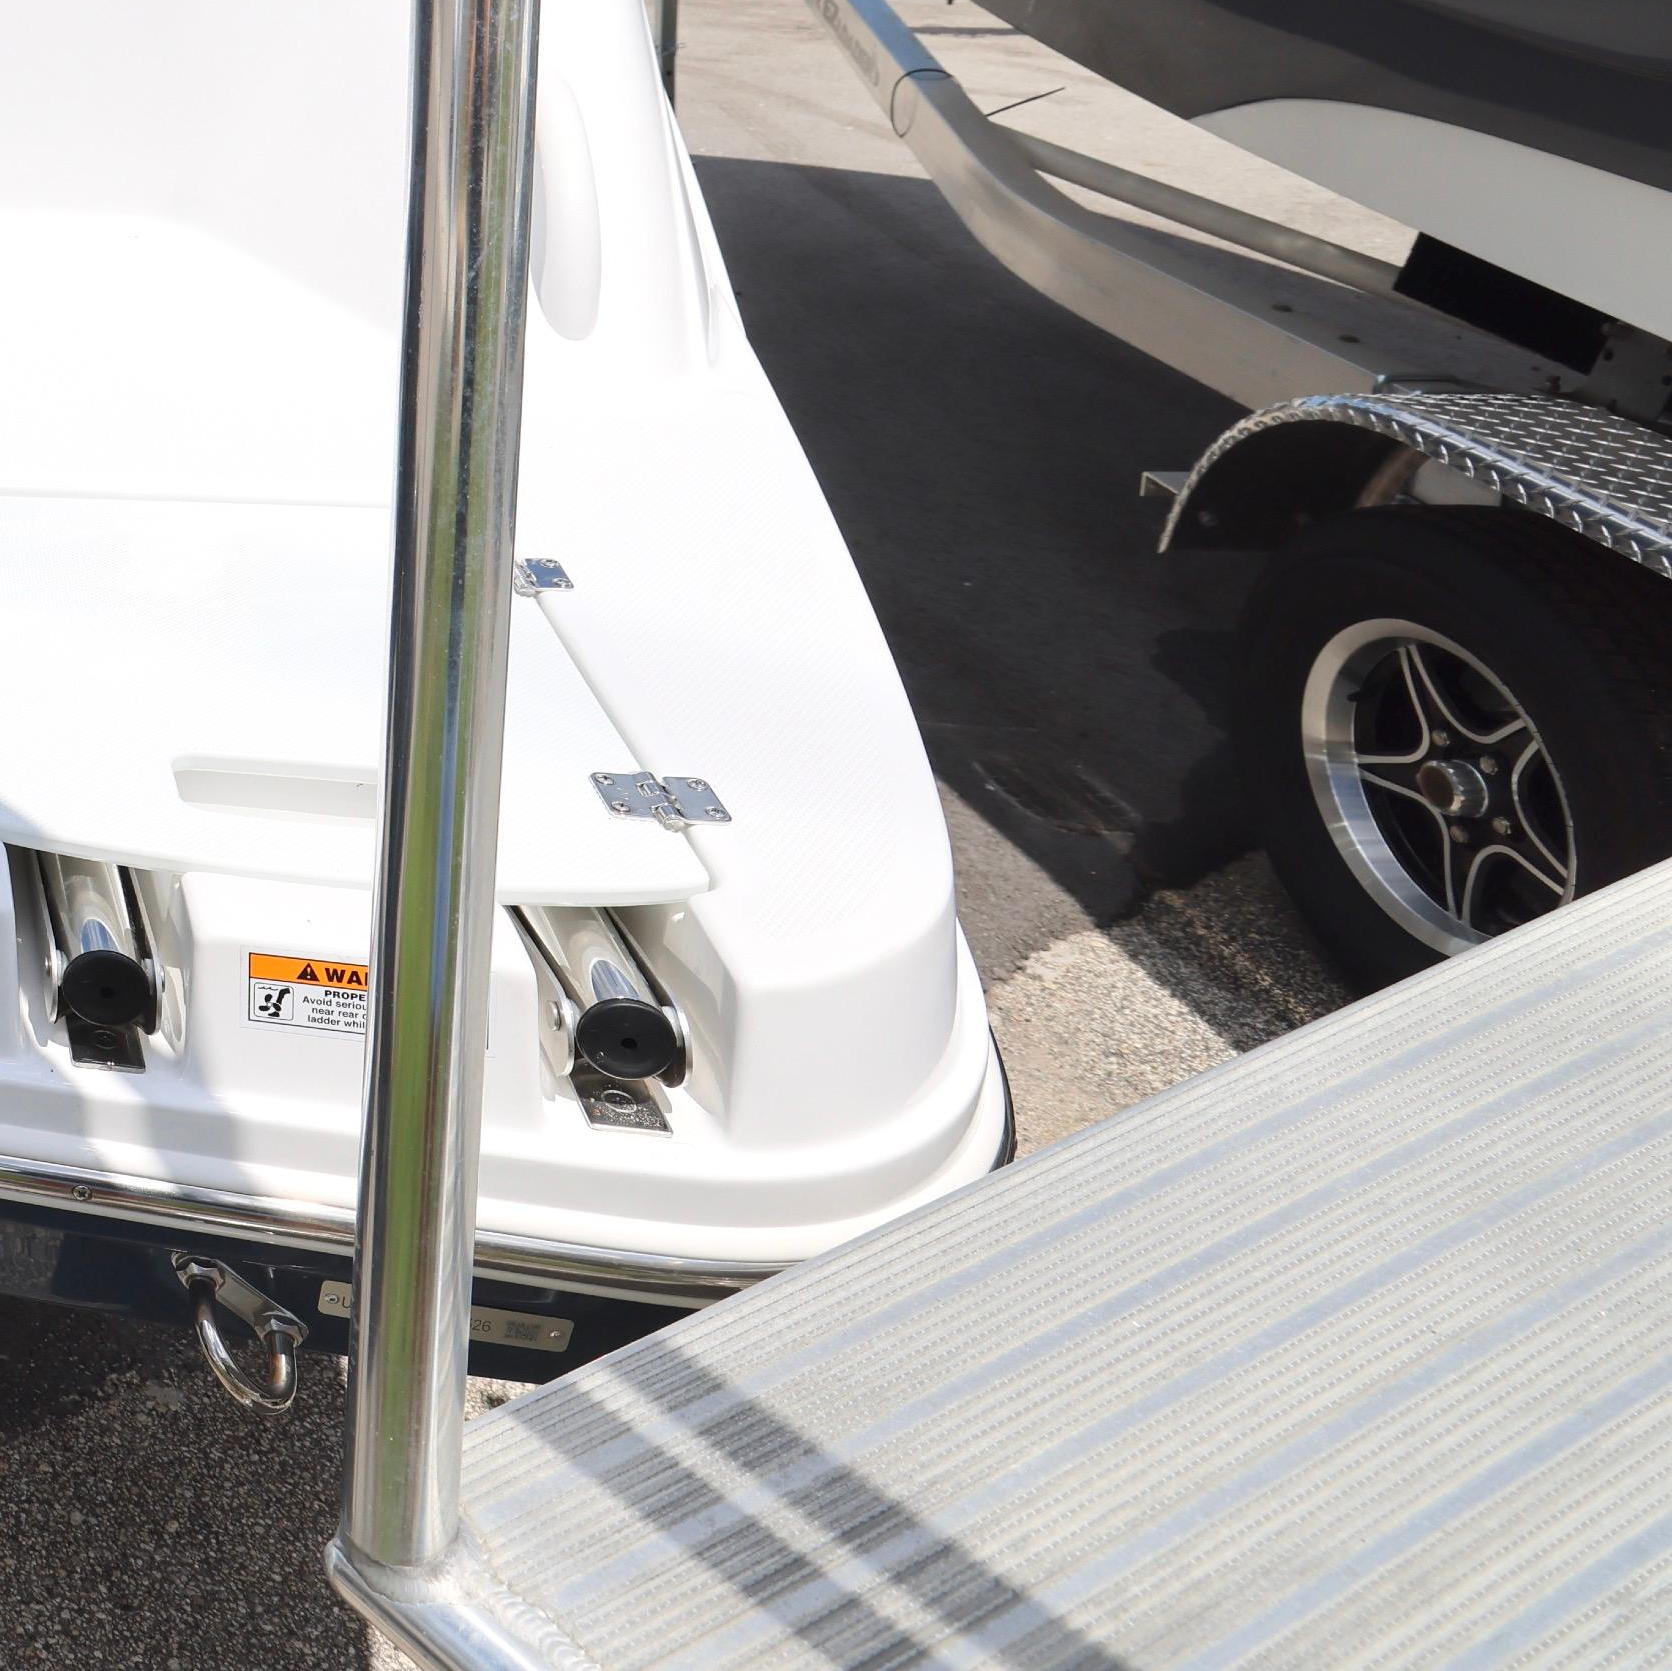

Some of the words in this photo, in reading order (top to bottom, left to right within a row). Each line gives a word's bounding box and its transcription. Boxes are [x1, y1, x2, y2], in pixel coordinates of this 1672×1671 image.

[324, 967, 368, 986] WA
[324, 990, 366, 1002] PROPE
[302, 996, 332, 1007] Avoid
[335, 1001, 367, 1011] seriou
[312, 1008, 335, 1017] near
[338, 1010, 359, 1020] rear
[307, 1015, 341, 1026] ladder
[344, 1020, 365, 1029] whil
